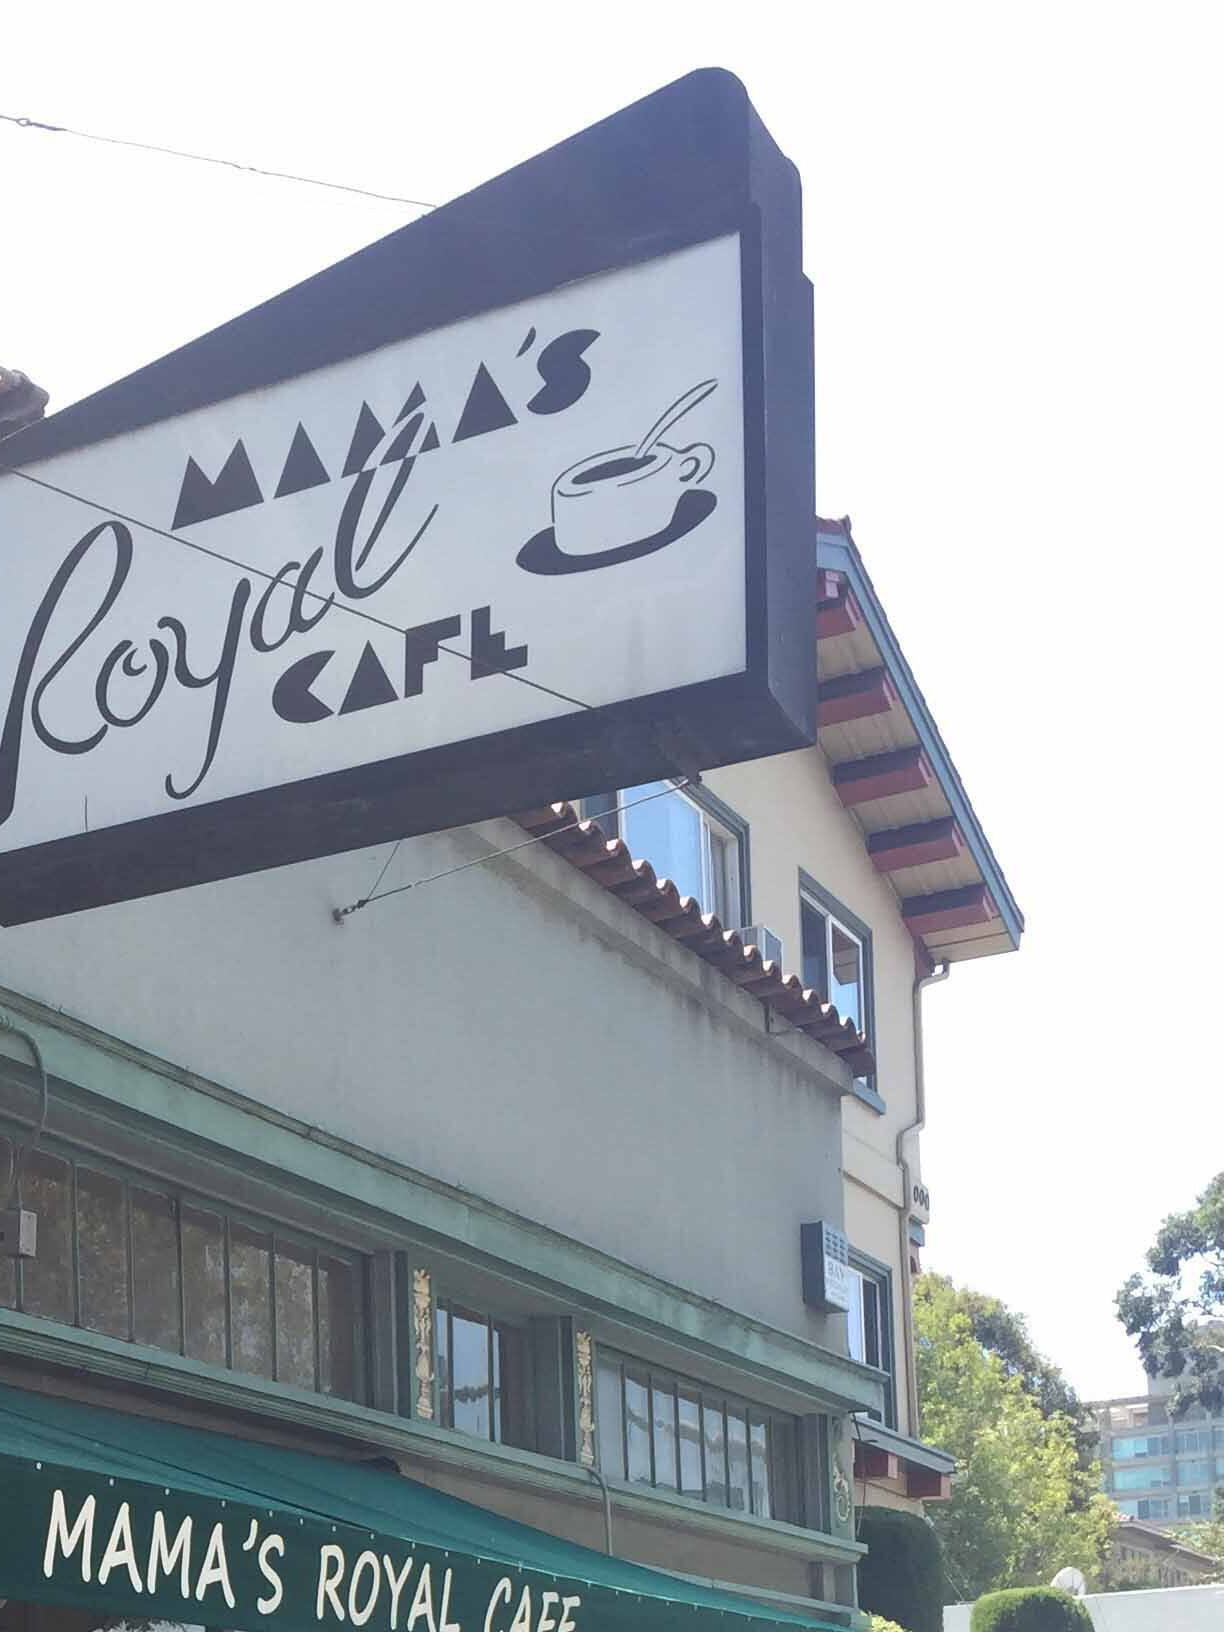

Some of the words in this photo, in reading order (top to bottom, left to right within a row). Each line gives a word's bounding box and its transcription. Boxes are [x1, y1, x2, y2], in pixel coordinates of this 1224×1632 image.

[171, 326, 601, 531] MAMA'S
[271, 605, 529, 724] CAFE
[42, 1489, 285, 1615] MAMA'S
